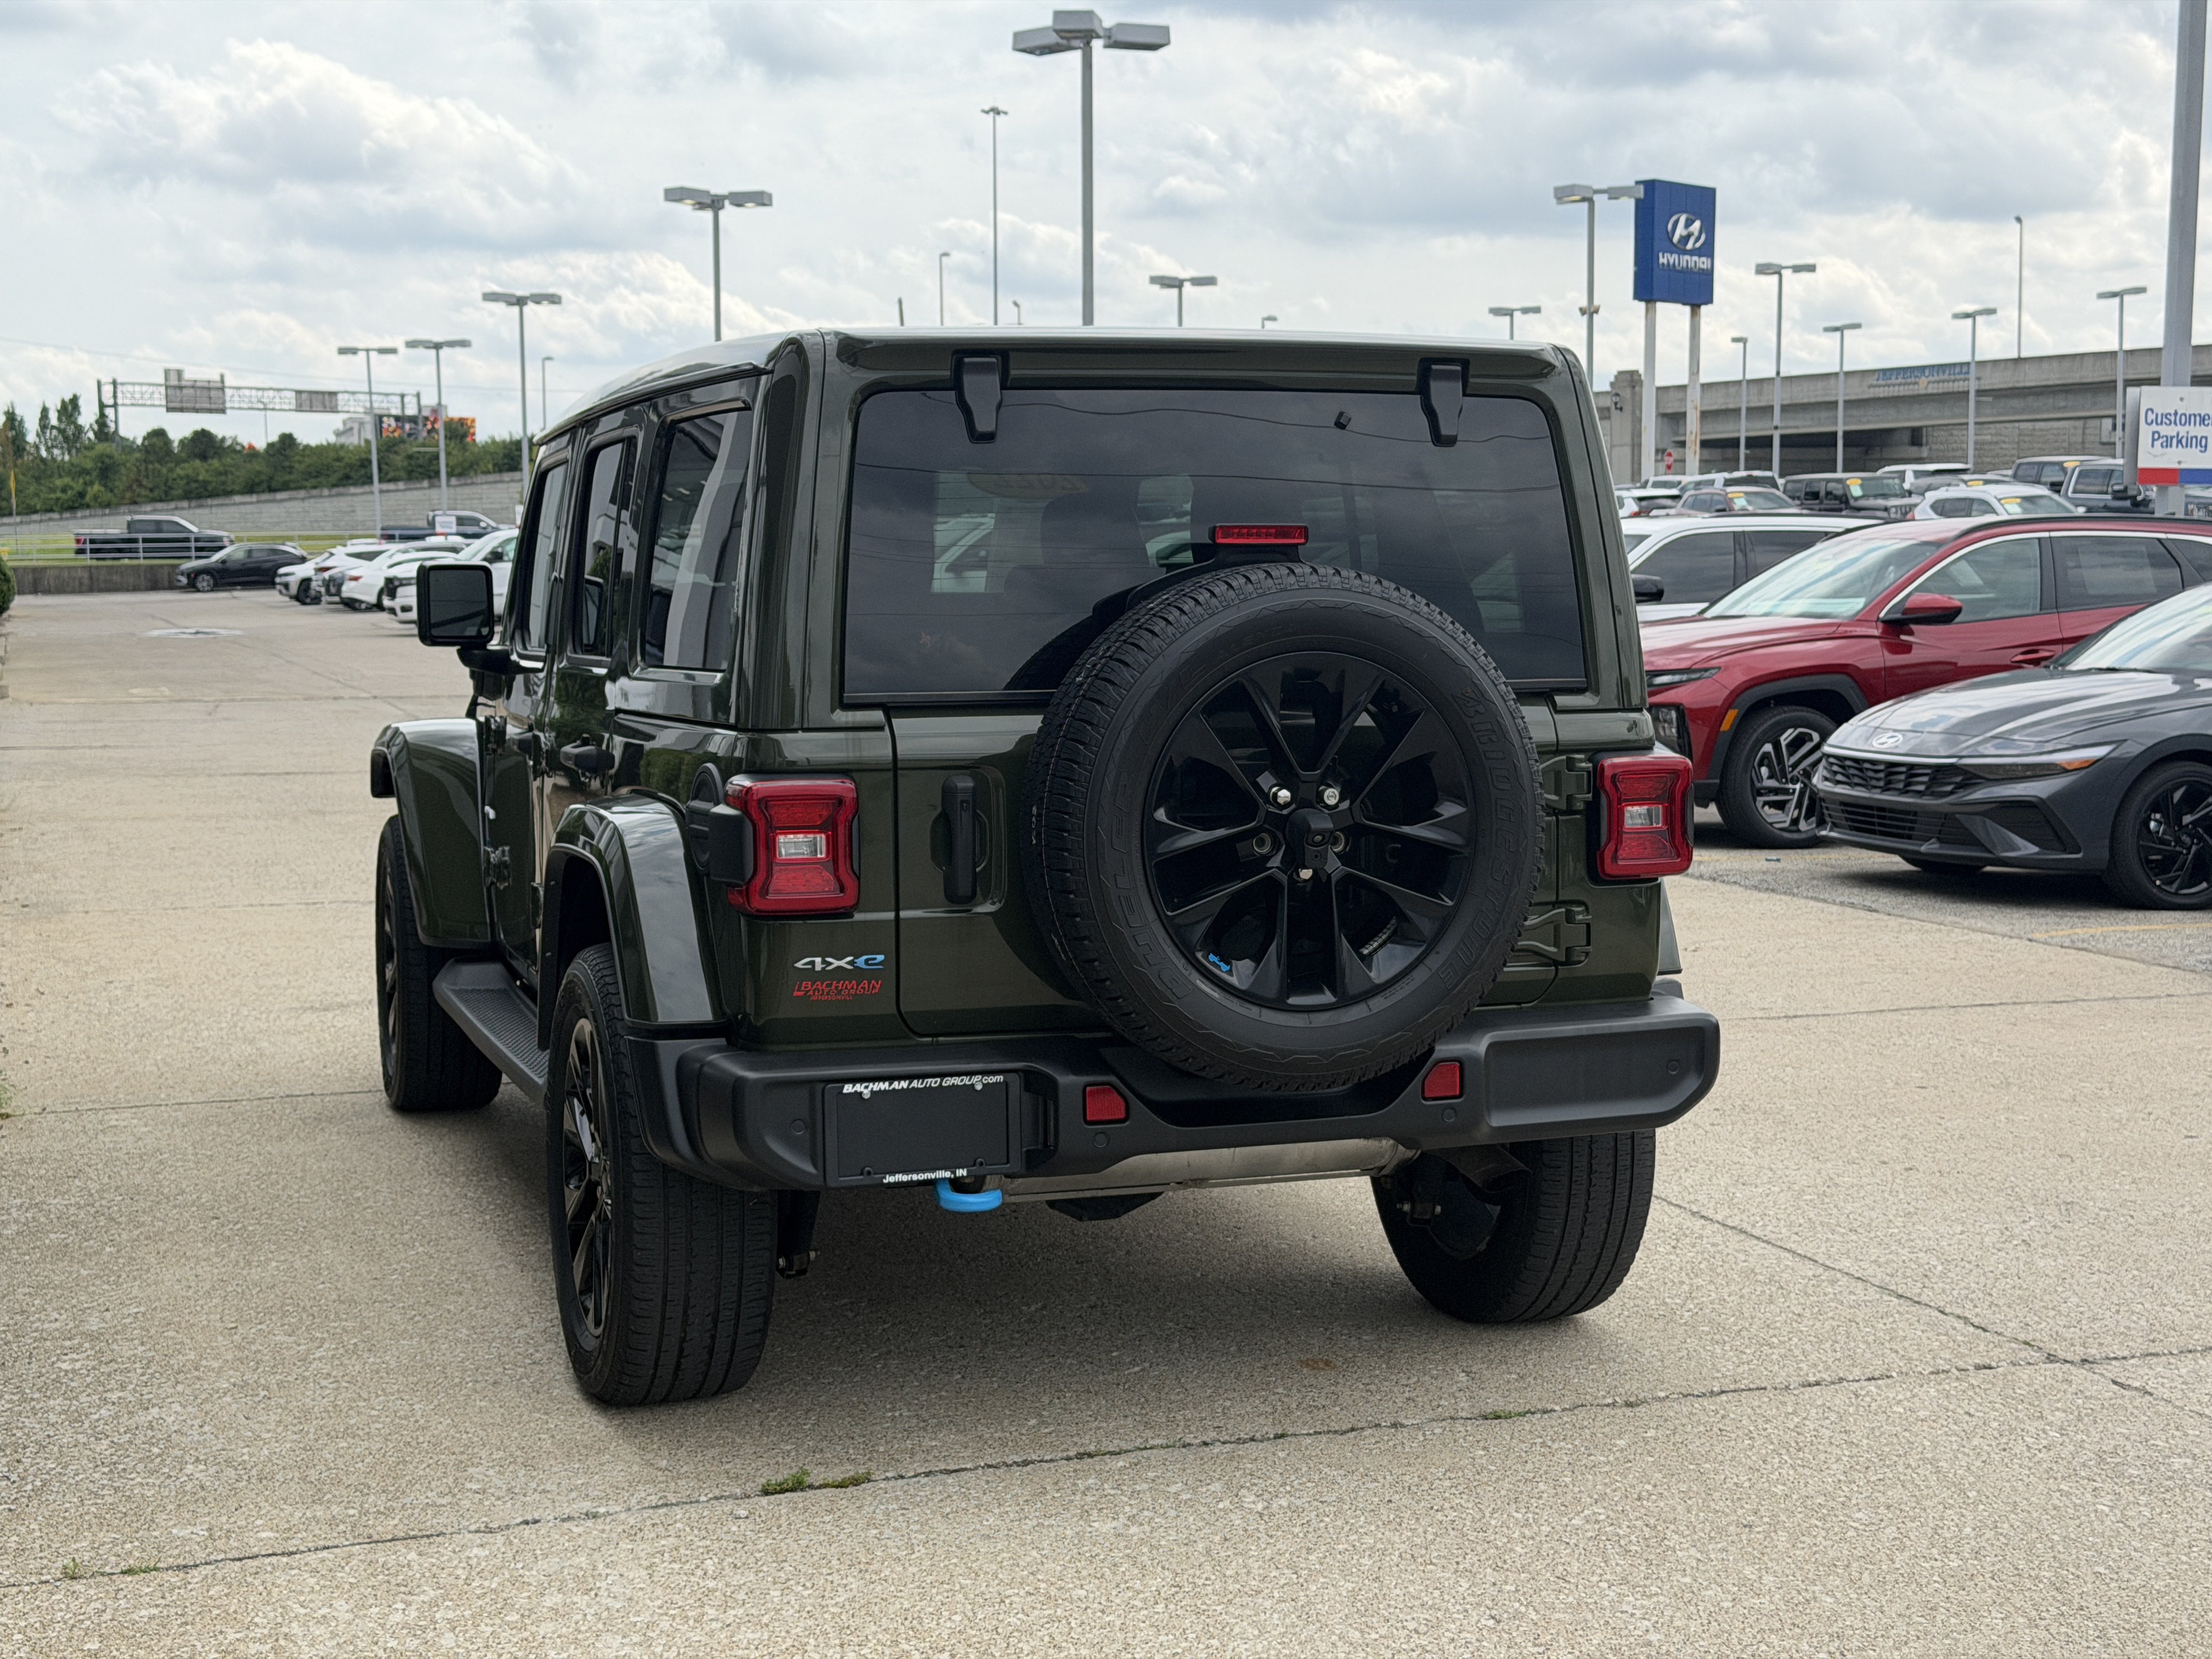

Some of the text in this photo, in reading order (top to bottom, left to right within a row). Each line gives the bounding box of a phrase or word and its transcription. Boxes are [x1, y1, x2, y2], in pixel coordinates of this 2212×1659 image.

[1658, 251, 1711, 272] HYUNDAI
[2145, 408, 2212, 427] Custome
[2151, 431, 2208, 454] Parking
[1438, 689, 1517, 990] BRIDGESTONE
[801, 980, 882, 991] BACHMAN
[843, 1080, 909, 1093] BACHMAN
[909, 1077, 940, 1089] AUTO
[883, 1168, 967, 1183] Jeffersonville, IN
